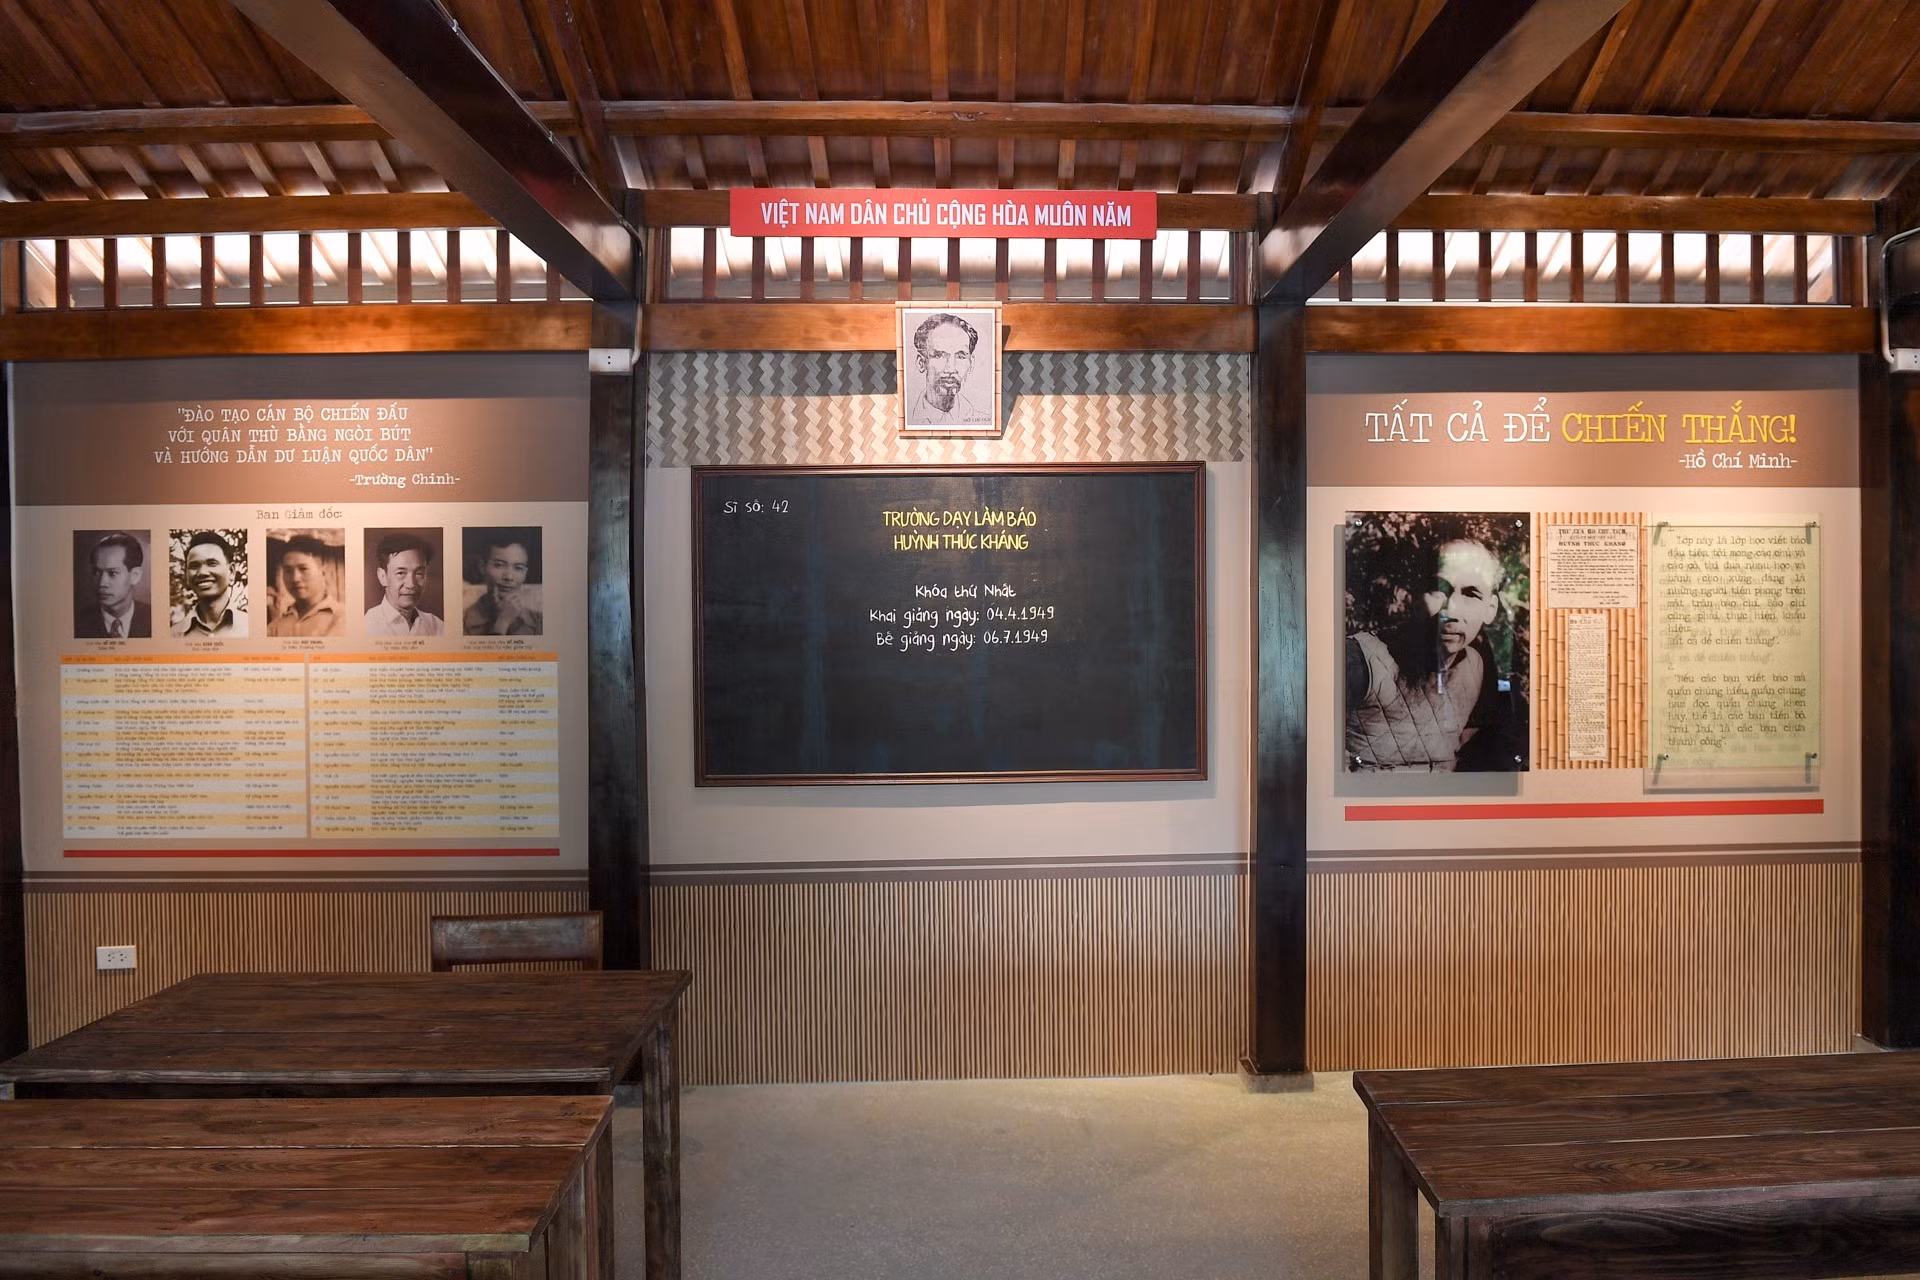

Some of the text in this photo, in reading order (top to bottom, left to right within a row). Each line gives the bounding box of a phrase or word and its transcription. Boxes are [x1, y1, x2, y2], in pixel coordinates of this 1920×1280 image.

[761, 198, 1131, 229] VIỆT NAM DÂN CHỦ CỘNG HÒA MUÔN NĂM
[221, 409, 250, 424] TẠO
[256, 404, 286, 422] CÁN
[293, 405, 314, 423] BỘ
[320, 402, 370, 421] CHIẾN
[377, 402, 408, 421] ĐẤU
[1365, 397, 1798, 443] TẤT CẢ ĐỂ CHIẾN THẮNG!
[168, 423, 411, 445] VỚI QUÂN THÙ BẰNG NGÒI BÚT
[154, 447, 172, 464] VÀ
[180, 446, 229, 463] HƯỚNG
[236, 445, 267, 463] DẪN
[274, 448, 295, 462] DƯ
[302, 446, 341, 464] LUẬN
[349, 444, 388, 464] QUỐC
[1679, 449, 1798, 469] -Hồ Chí Minh-
[349, 473, 461, 488] -Trường Chinh-
[772, 500, 789, 513] 42
[883, 506, 1037, 529] TRƯỜNG DẠY LÀM BÁO
[894, 529, 1029, 550] HUỲNH THÚC KHÁNG
[915, 583, 1017, 598] Khóa thứ Nhất
[869, 605, 1055, 629] Khai giảng ngày: 04.4.1949
[876, 629, 1048, 652] Bế giảng ngày: 06.7.1949
